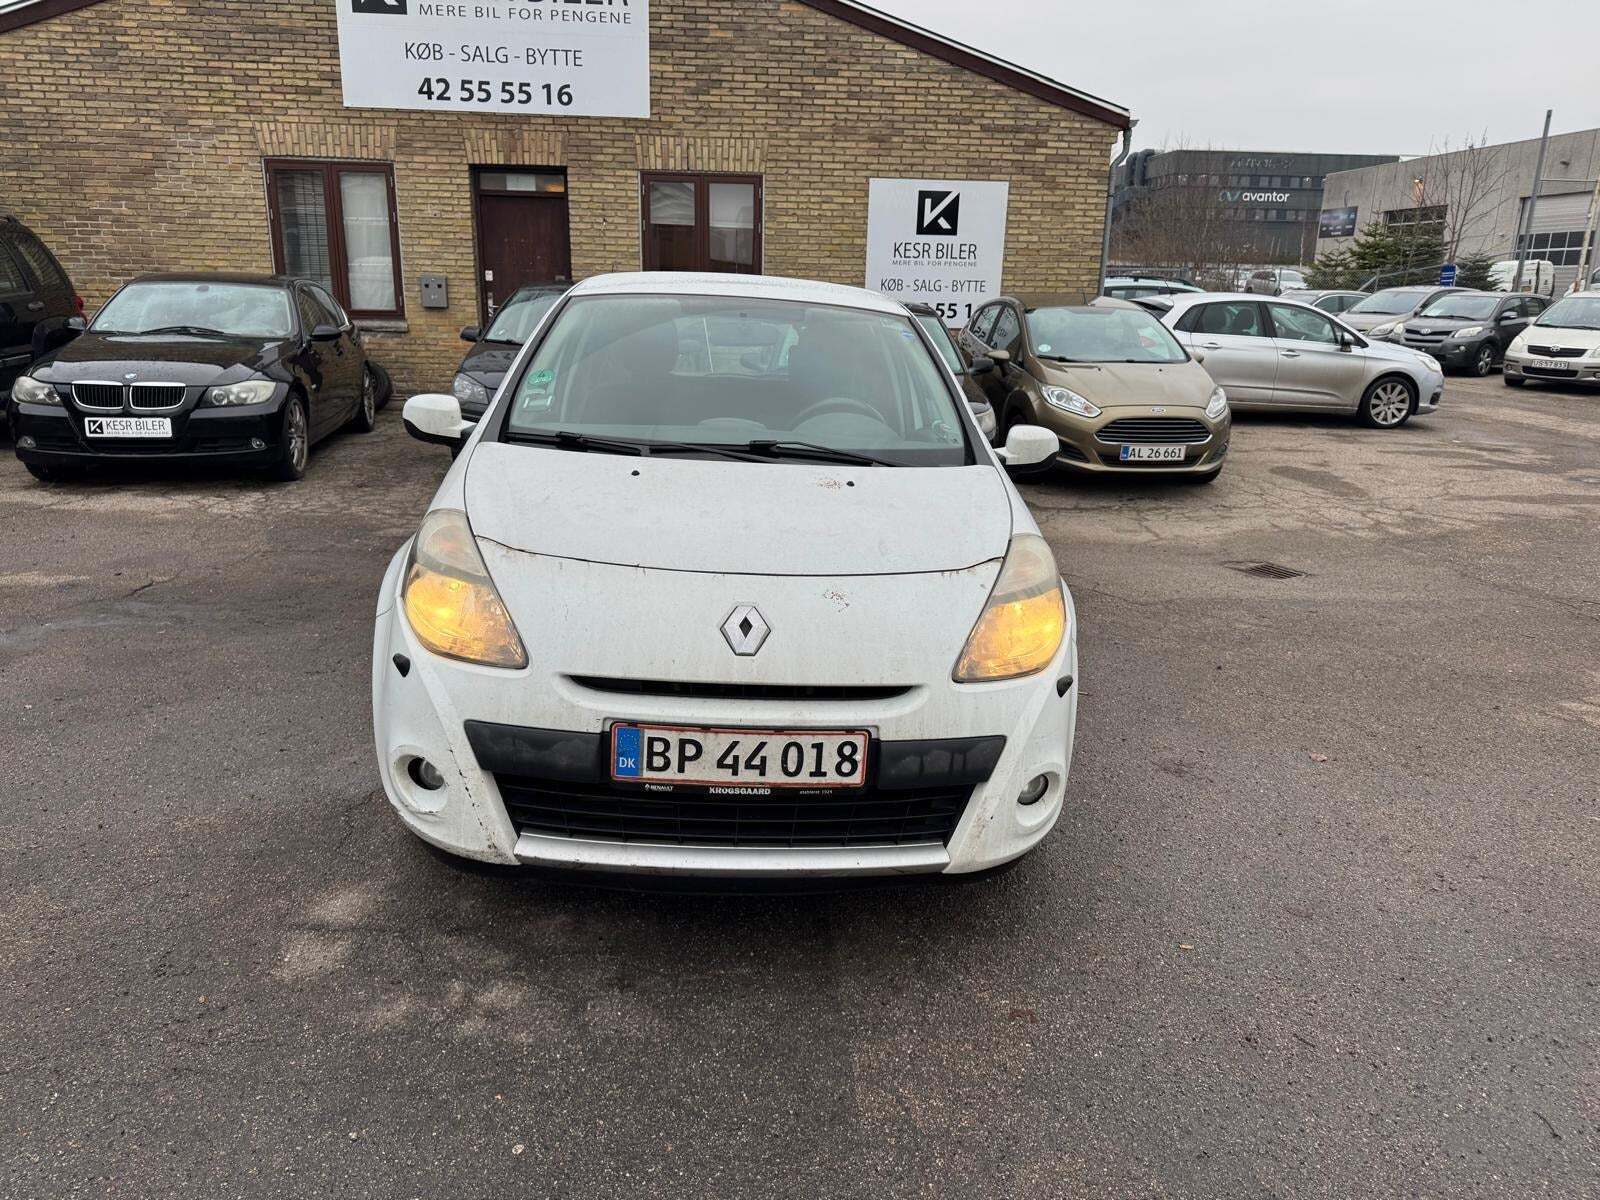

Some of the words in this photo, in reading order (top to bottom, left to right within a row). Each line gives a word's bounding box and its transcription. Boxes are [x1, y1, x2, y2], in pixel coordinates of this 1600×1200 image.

[419, 4, 467, 17] MERE
[475, 6, 501, 19] BIL
[508, 7, 543, 20] FOR
[550, 9, 632, 25] PENGENE
[404, 42, 444, 61] KØB
[460, 44, 509, 64] SALG
[526, 47, 584, 67] BYTTE
[417, 77, 452, 101] 42
[459, 79, 492, 103] 55
[500, 81, 532, 104] 55
[541, 83, 573, 107] 16
[1242, 191, 1290, 202] avantor
[893, 242, 931, 259] KESR
[935, 243, 977, 260] BILER
[880, 278, 904, 292] KØB
[913, 279, 942, 292] SALG
[951, 280, 986, 293] BYTTE
[105, 420, 132, 431] KESR
[135, 420, 166, 431] BILER
[1129, 447, 1143, 458] AL
[1147, 447, 1161, 459] 26
[1163, 447, 1182, 459] 661
[618, 757, 636, 769] DK
[645, 736, 703, 774] BP
[716, 740, 768, 777] 44
[780, 740, 859, 778] 018
[709, 786, 771, 795] KROGSGAARD
